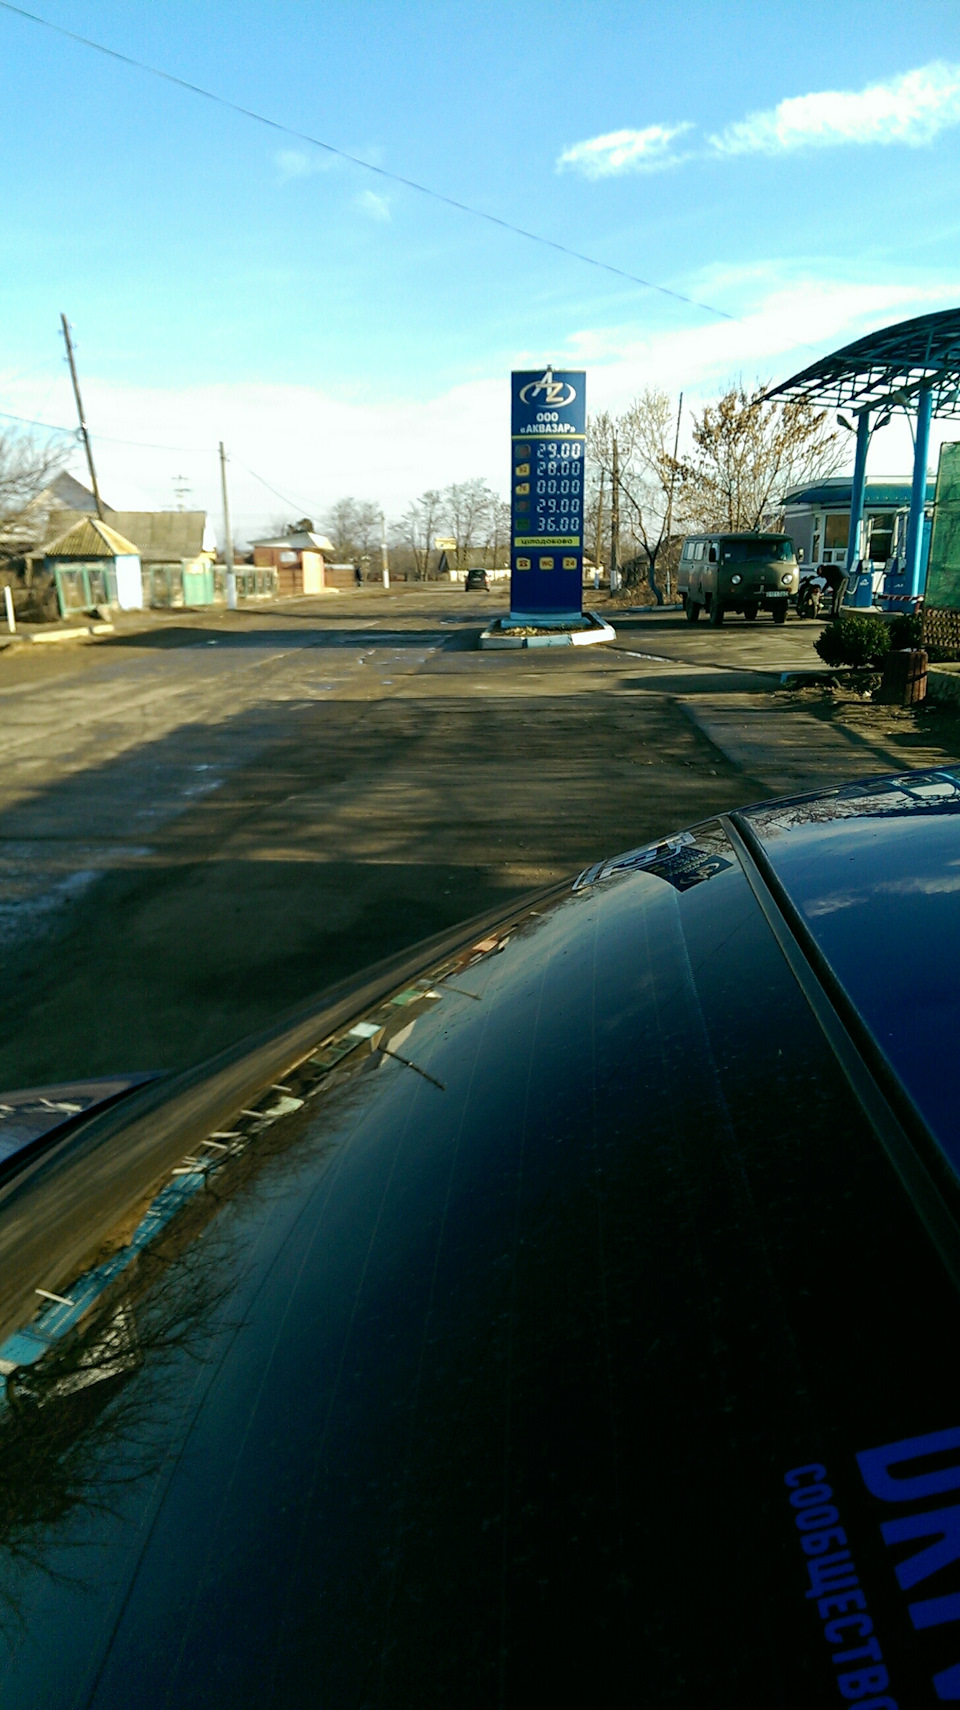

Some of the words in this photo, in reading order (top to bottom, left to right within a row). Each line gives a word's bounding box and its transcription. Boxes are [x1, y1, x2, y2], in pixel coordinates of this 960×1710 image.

[536, 412, 559, 422] ООО
[520, 423, 576, 434] «АКВАЗАР»
[537, 443, 581, 458] 29.00
[537, 461, 581, 476] 28.00
[536, 479, 580, 494] 00.00
[536, 498, 580, 513] 29.00
[537, 517, 580, 532] 36.00
